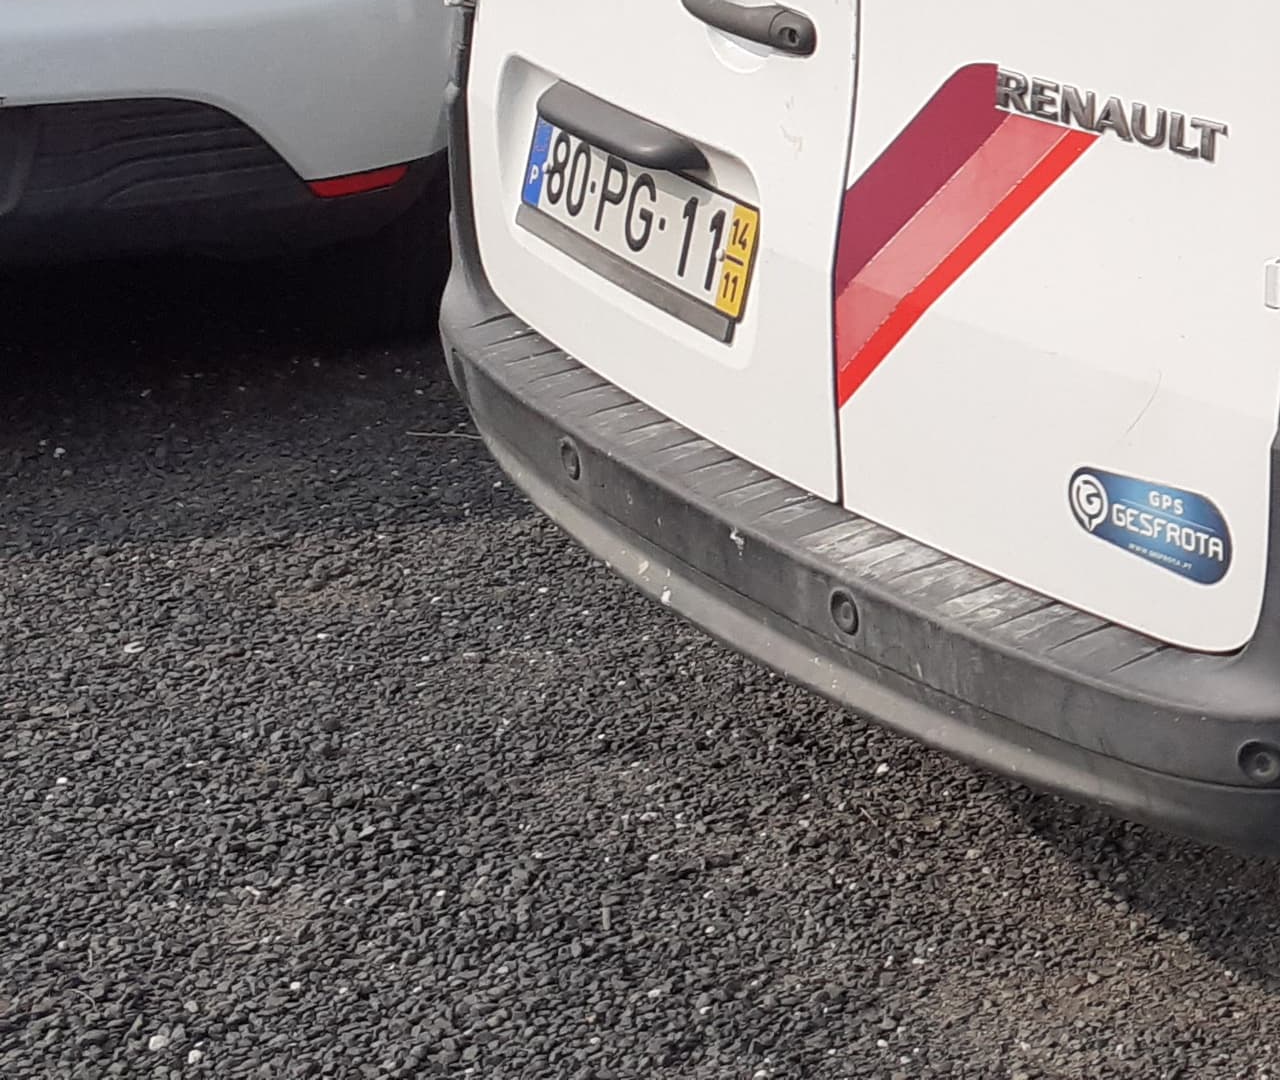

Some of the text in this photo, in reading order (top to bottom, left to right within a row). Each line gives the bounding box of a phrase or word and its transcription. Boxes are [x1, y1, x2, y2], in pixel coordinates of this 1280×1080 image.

[996, 67, 1230, 162] RENAULT
[731, 218, 750, 251] 14
[721, 271, 740, 303] 11
[1148, 490, 1185, 515] GPS
[1111, 502, 1224, 562] GESFROTA
